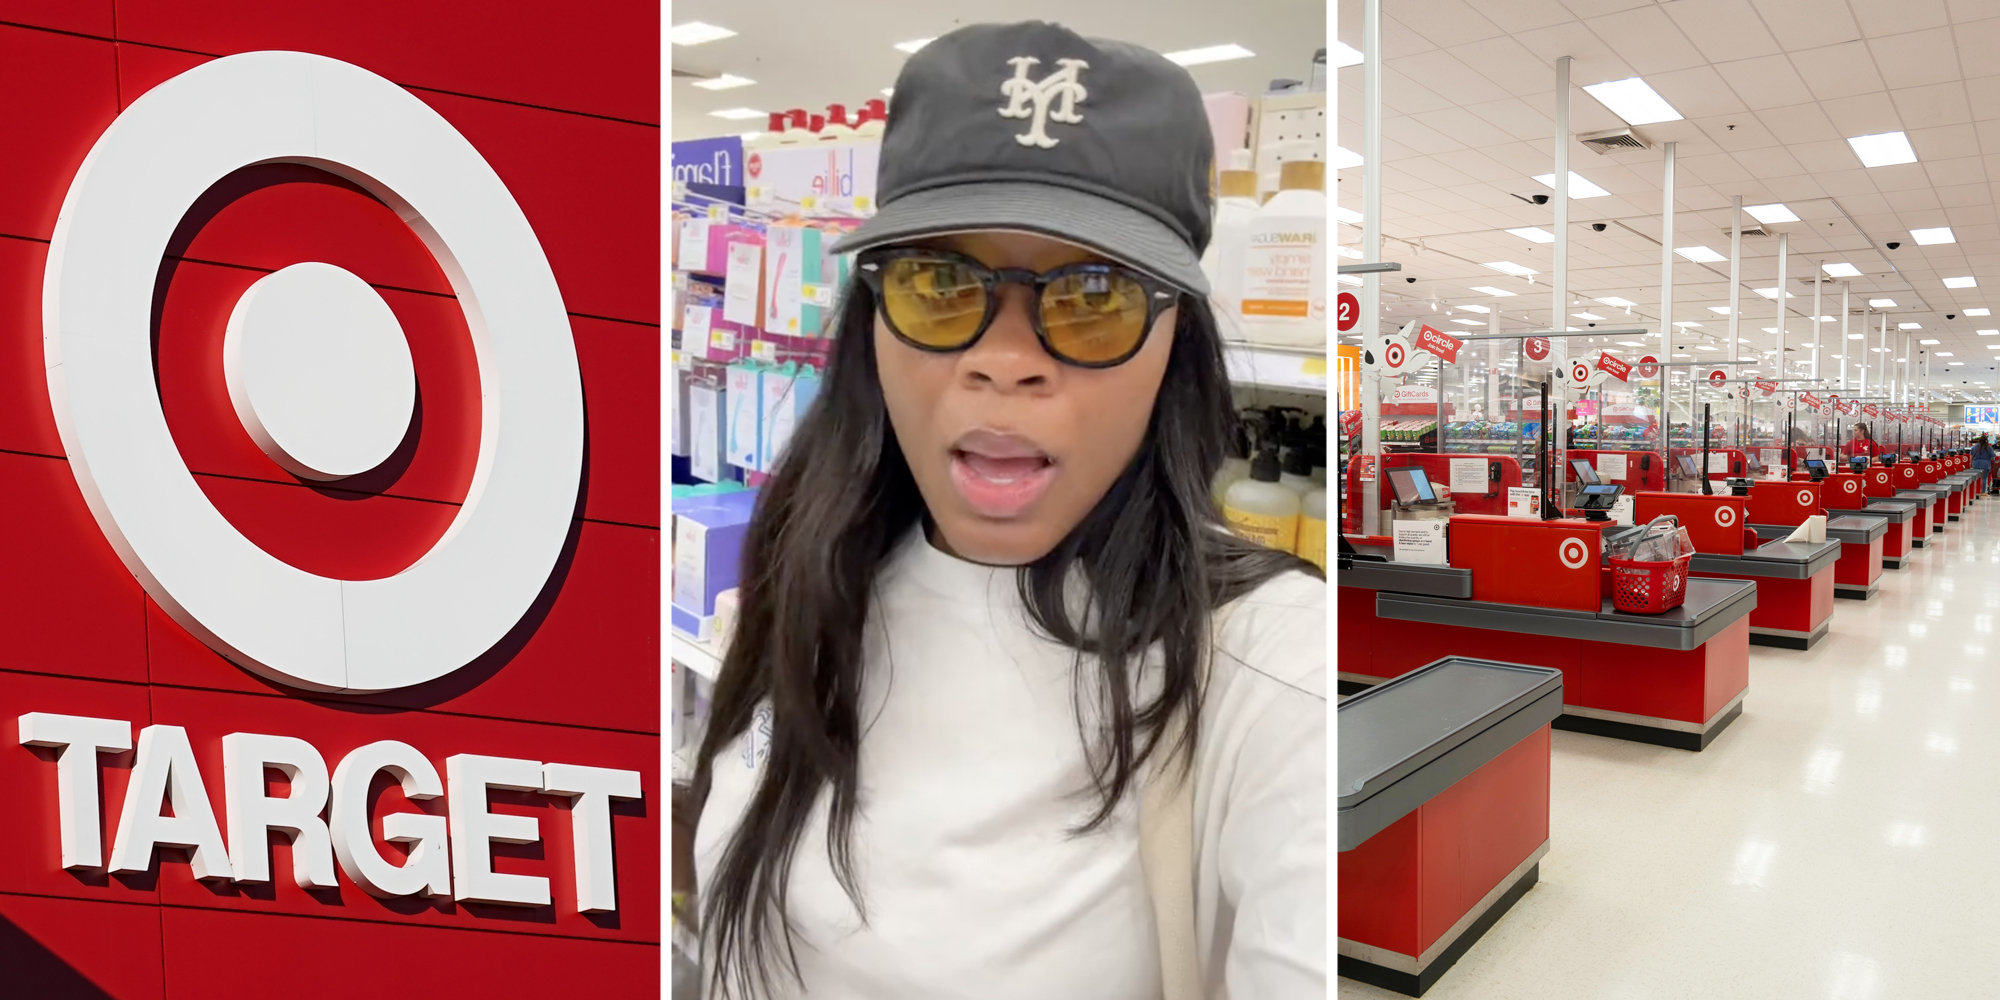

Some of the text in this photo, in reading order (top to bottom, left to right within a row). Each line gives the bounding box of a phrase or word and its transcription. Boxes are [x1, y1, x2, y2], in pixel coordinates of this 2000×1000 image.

[1338, 302, 1350, 321] 2
[1431, 334, 1454, 350] circle
[1533, 340, 1543, 353] 3
[1401, 390, 1429, 398] GiftCards
[18, 711, 641, 914] TARGET
